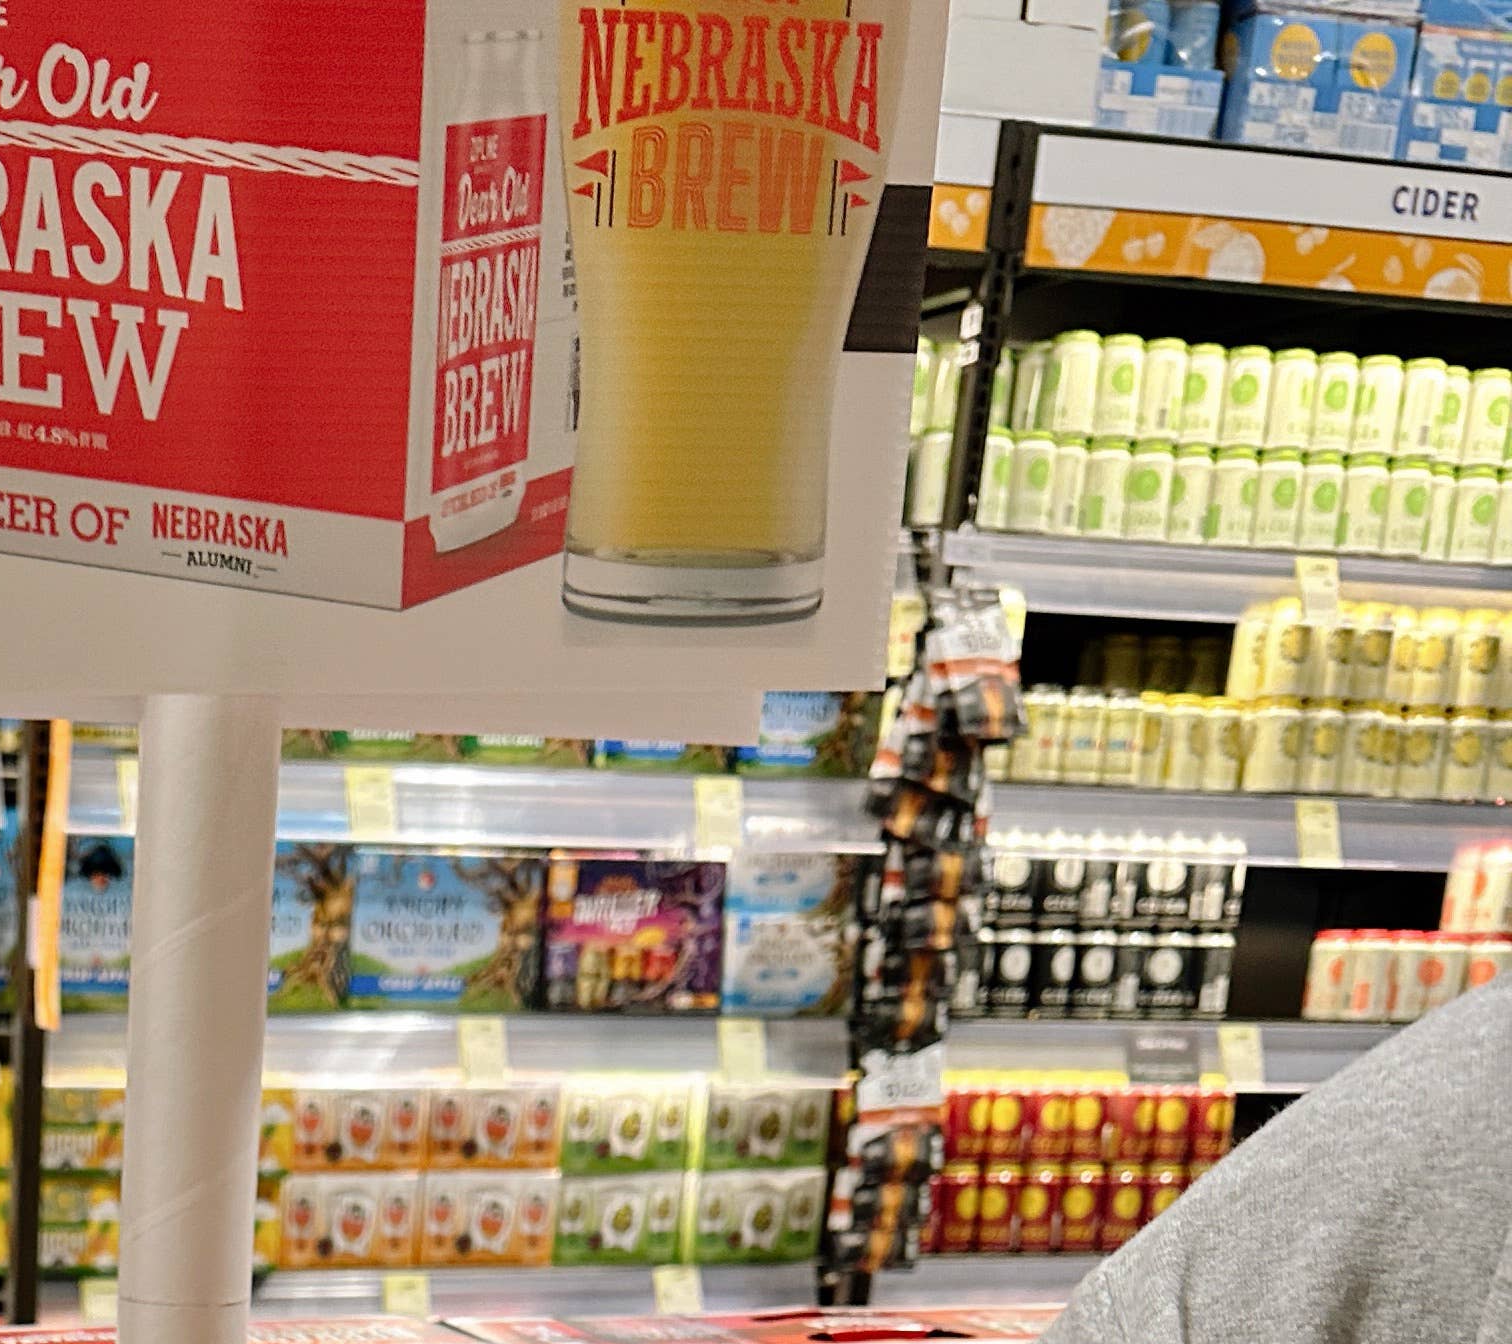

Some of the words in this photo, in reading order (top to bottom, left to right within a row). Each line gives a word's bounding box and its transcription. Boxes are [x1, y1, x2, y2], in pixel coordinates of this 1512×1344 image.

[38, 42, 160, 121] Old
[572, 8, 884, 153] NEBRASKA
[627, 121, 825, 235] BREW
[1391, 184, 1481, 223] CIDER
[440, 348, 528, 458] BREW
[70, 501, 130, 545] OF
[152, 502, 289, 557] NEBRASKA
[186, 552, 253, 576] ALUMNI
